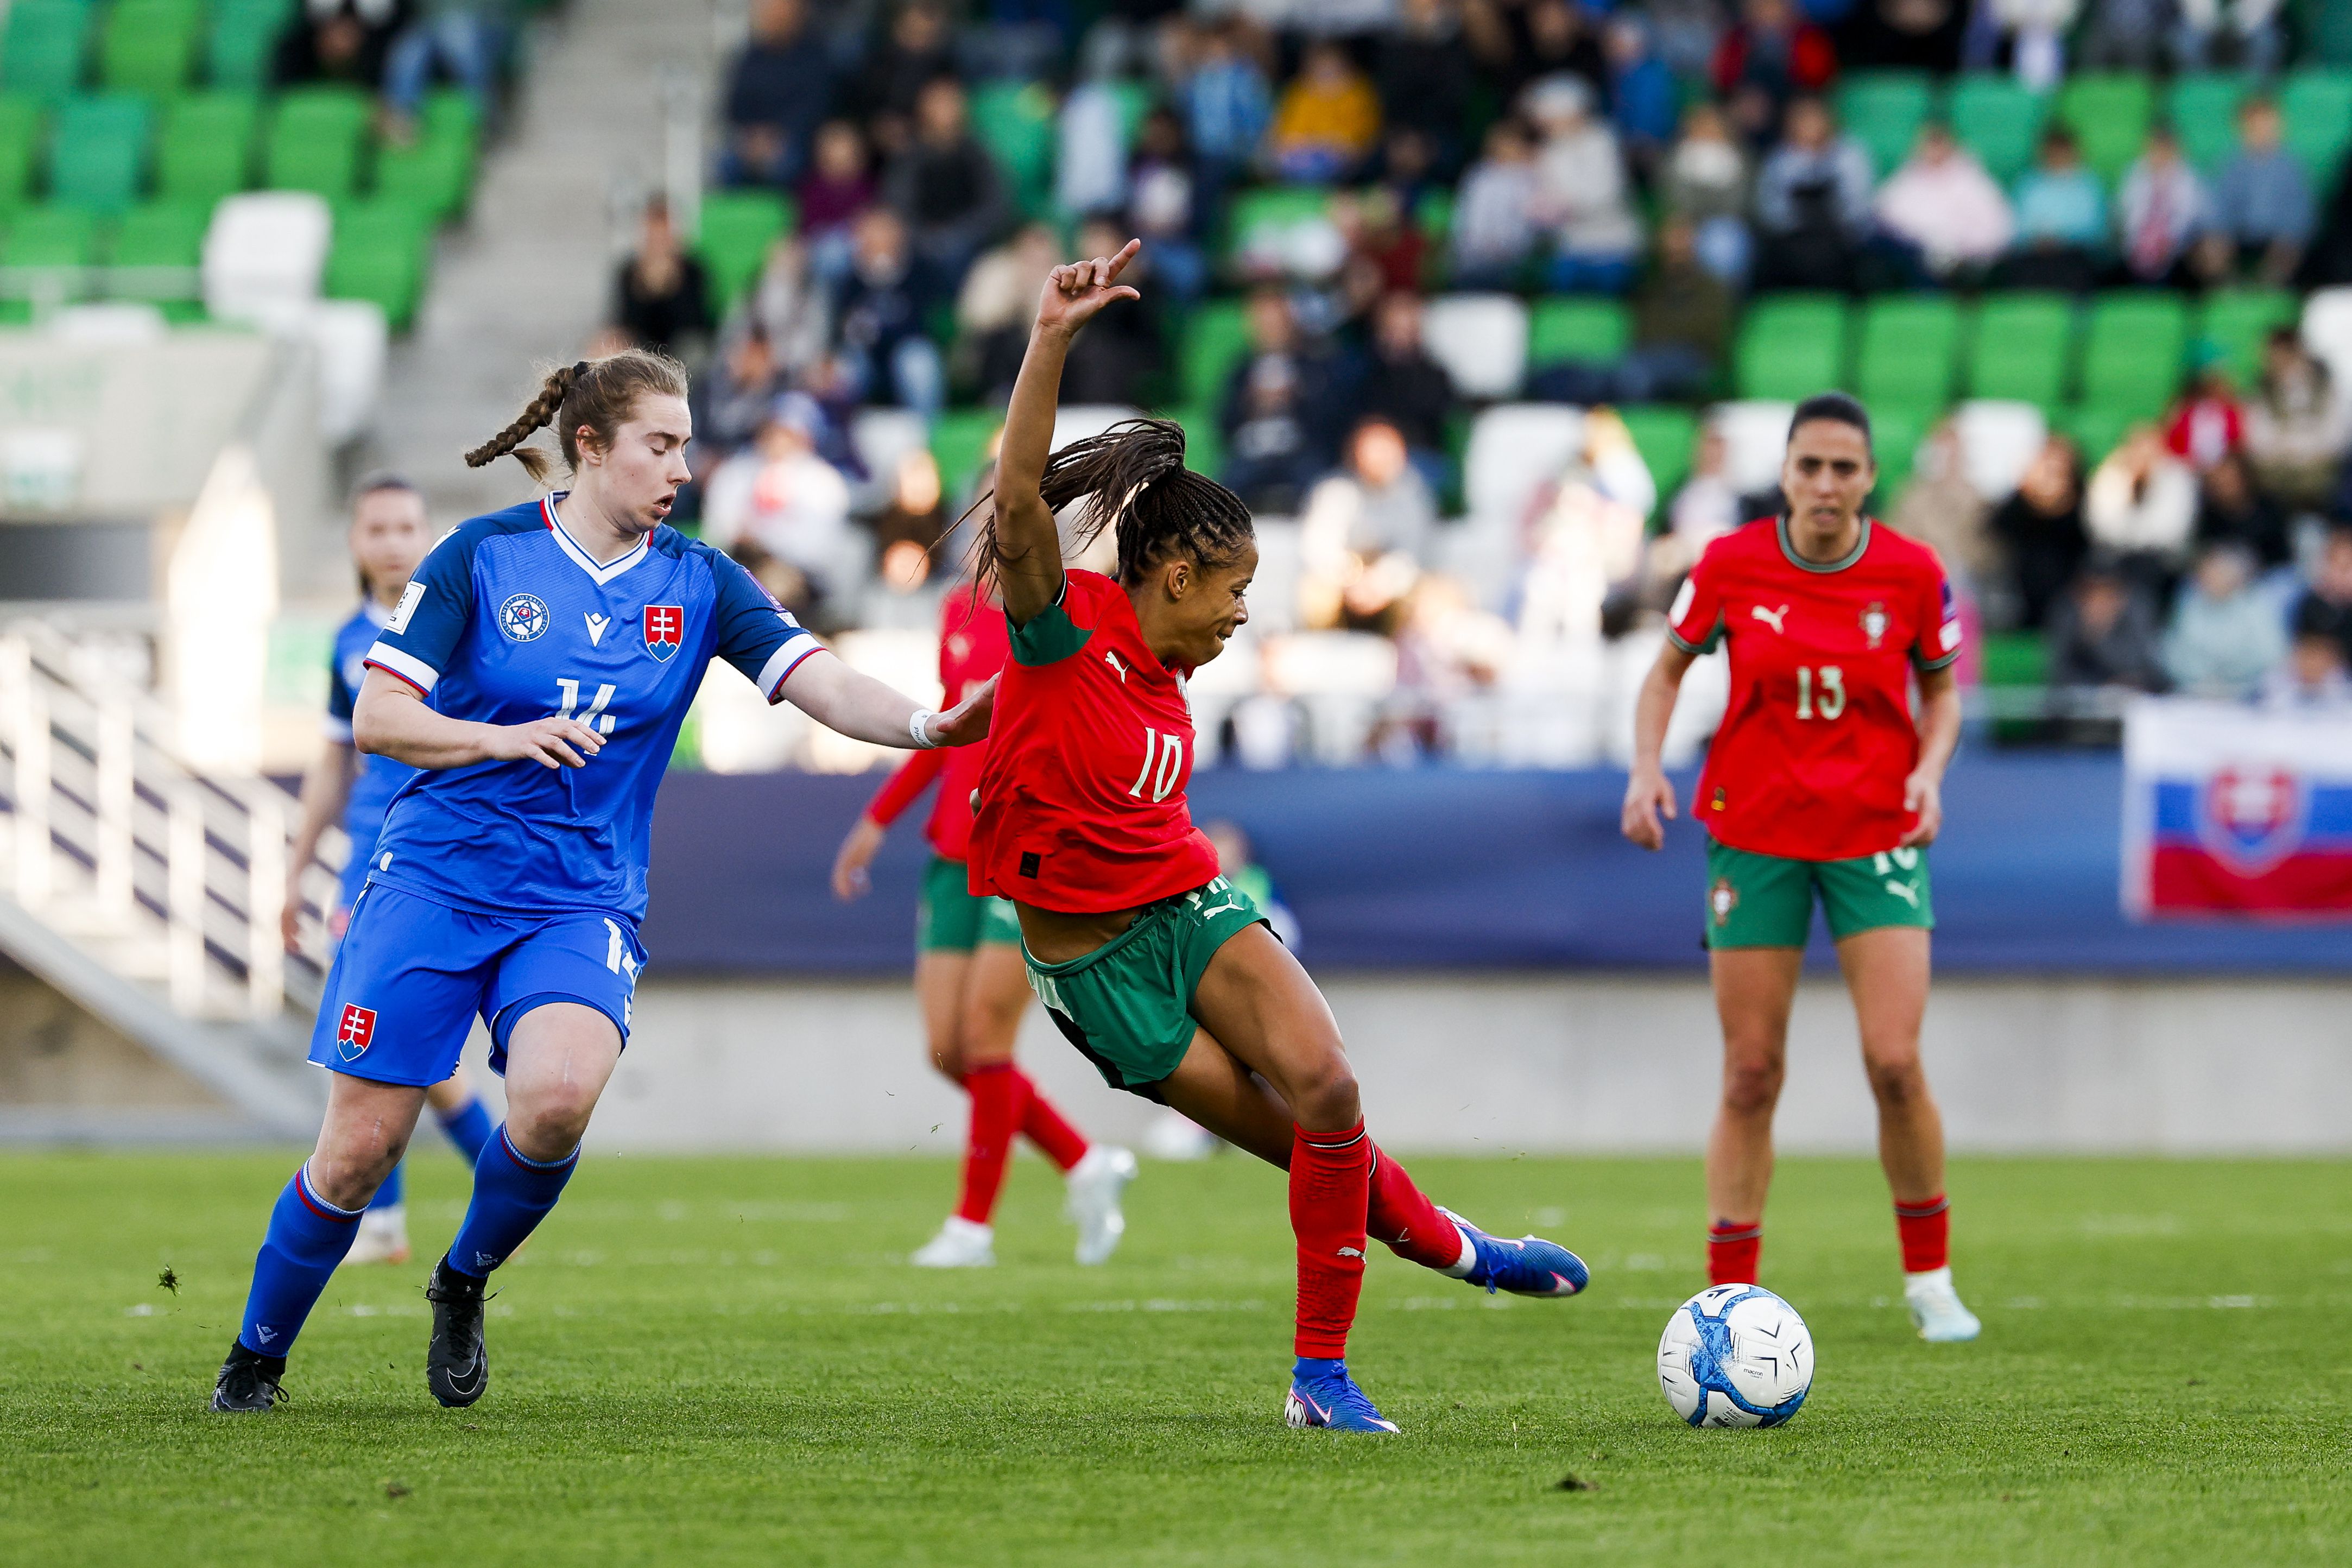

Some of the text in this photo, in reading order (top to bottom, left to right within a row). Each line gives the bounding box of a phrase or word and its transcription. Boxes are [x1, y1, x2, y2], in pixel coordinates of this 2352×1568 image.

[557, 678, 617, 756] 14
[1795, 665, 1847, 720] 13
[1129, 727, 1183, 803] 10
[1743, 1368, 1763, 1376] macron
